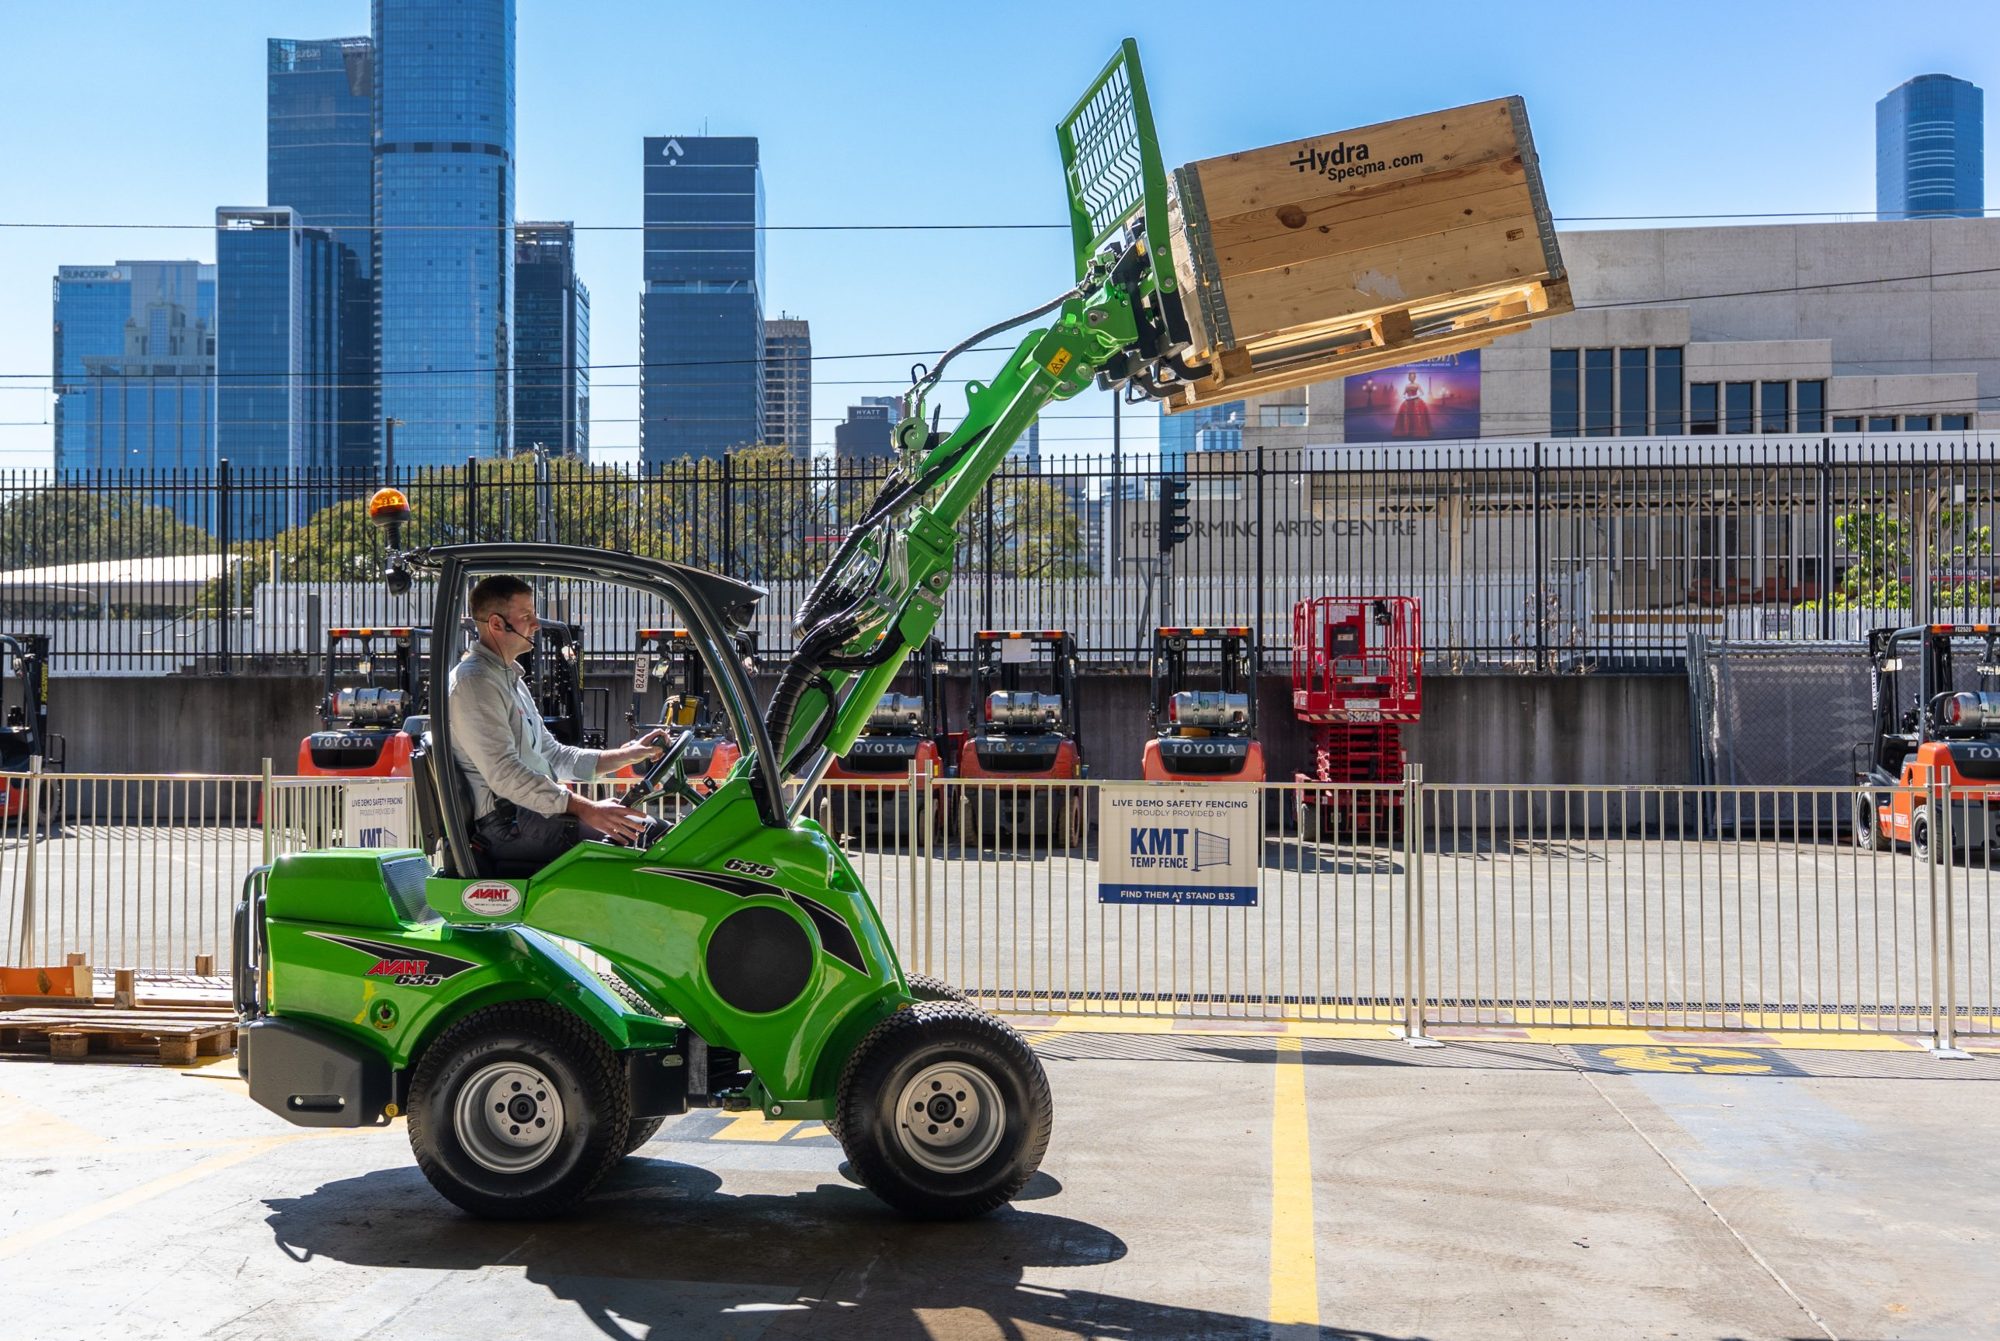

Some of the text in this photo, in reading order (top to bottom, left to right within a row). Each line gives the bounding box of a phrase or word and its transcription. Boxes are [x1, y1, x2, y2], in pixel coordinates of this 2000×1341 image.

[1290, 142, 1369, 174] Hydra
[63, 270, 109, 279] SUNCORP
[1130, 519, 1417, 538] PERORMING ARTS CENTRE
[317, 737, 373, 748] TOYOTA
[854, 743, 906, 753] OYOTA
[986, 742, 1046, 753] TOYO
[1172, 743, 1236, 754] TOYOTA
[1112, 799, 1248, 809] LIVE DEMO SAFETY FENCING
[1132, 809, 1228, 818] PROUDLY PROVIDED BY
[360, 827, 382, 848] KMT
[1130, 827, 1189, 856] KMT
[723, 858, 778, 878] 635
[1130, 857, 1188, 869] TEMP FENCE
[468, 888, 510, 900] AVANT
[1120, 890, 1236, 900] FIND THEM AT STAND B35
[364, 959, 429, 976] AVANT
[394, 974, 443, 987] 635
